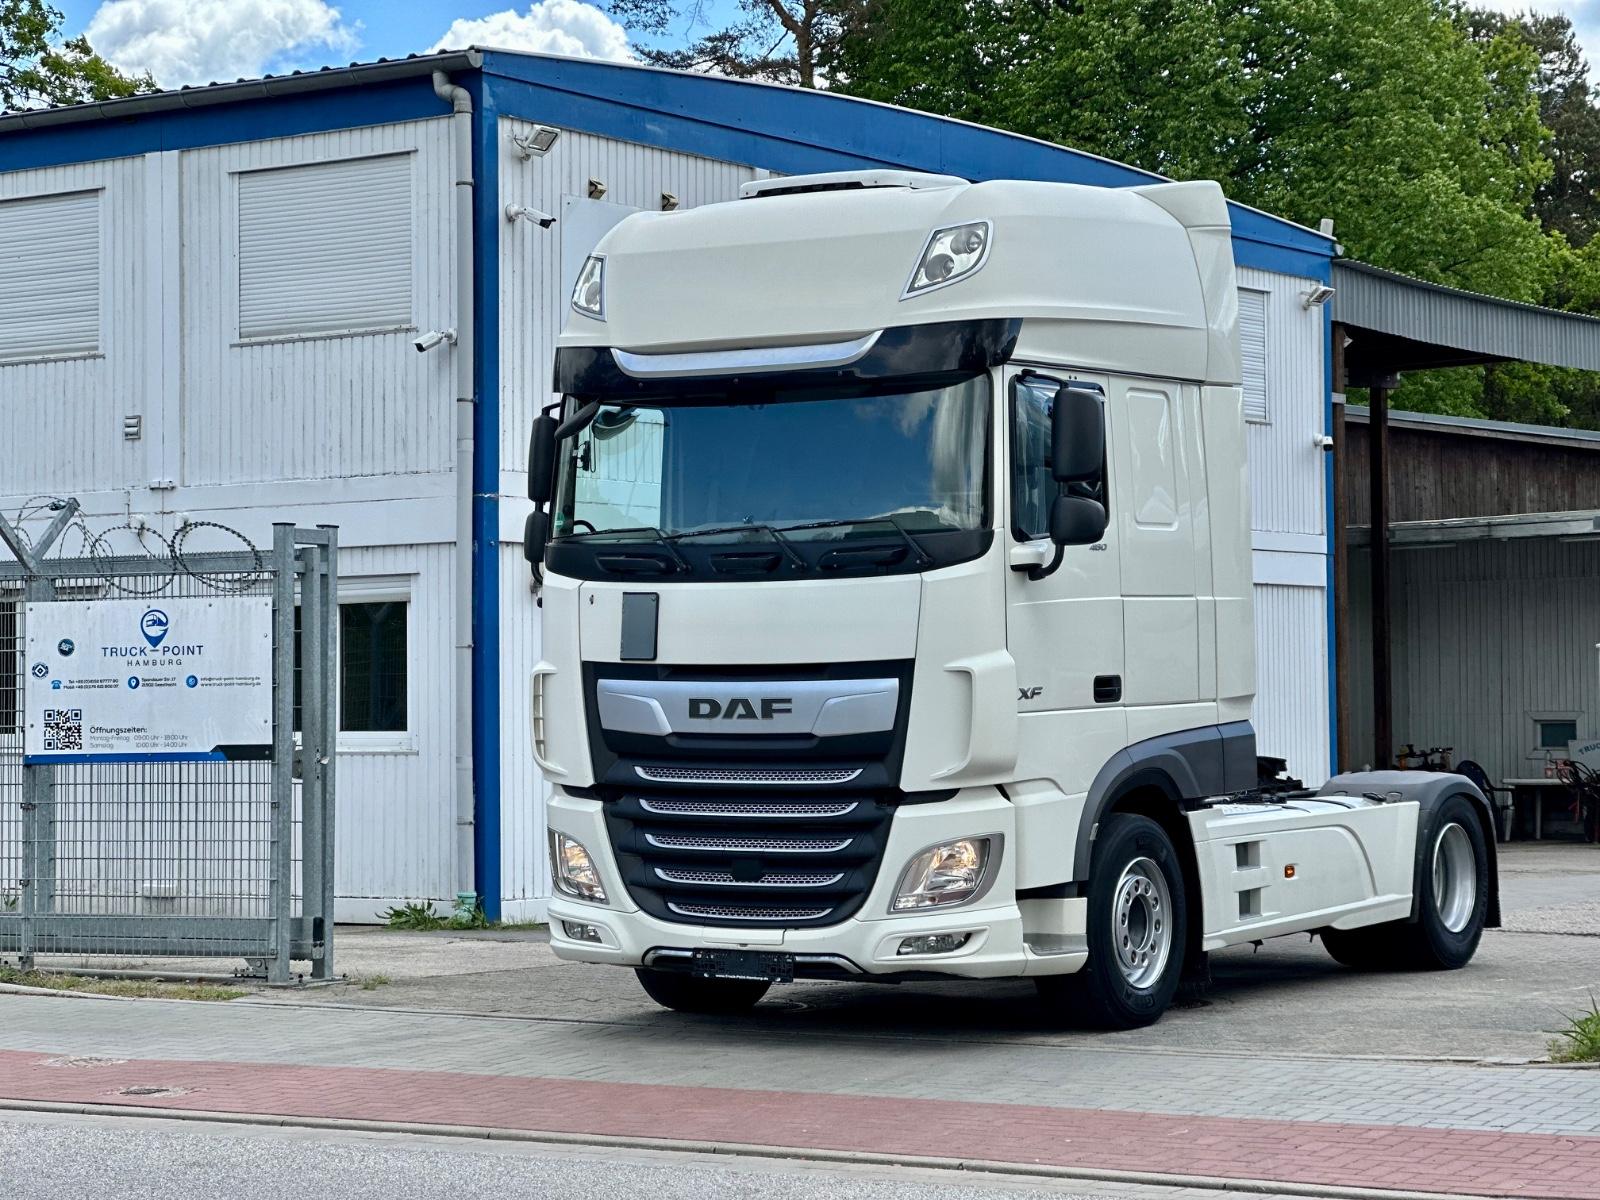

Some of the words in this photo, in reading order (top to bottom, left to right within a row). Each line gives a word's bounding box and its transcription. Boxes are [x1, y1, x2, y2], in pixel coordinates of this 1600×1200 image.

[127, 659, 182, 667] HAMBURG
[1017, 687, 1043, 700] XF
[688, 698, 792, 719] DAF
